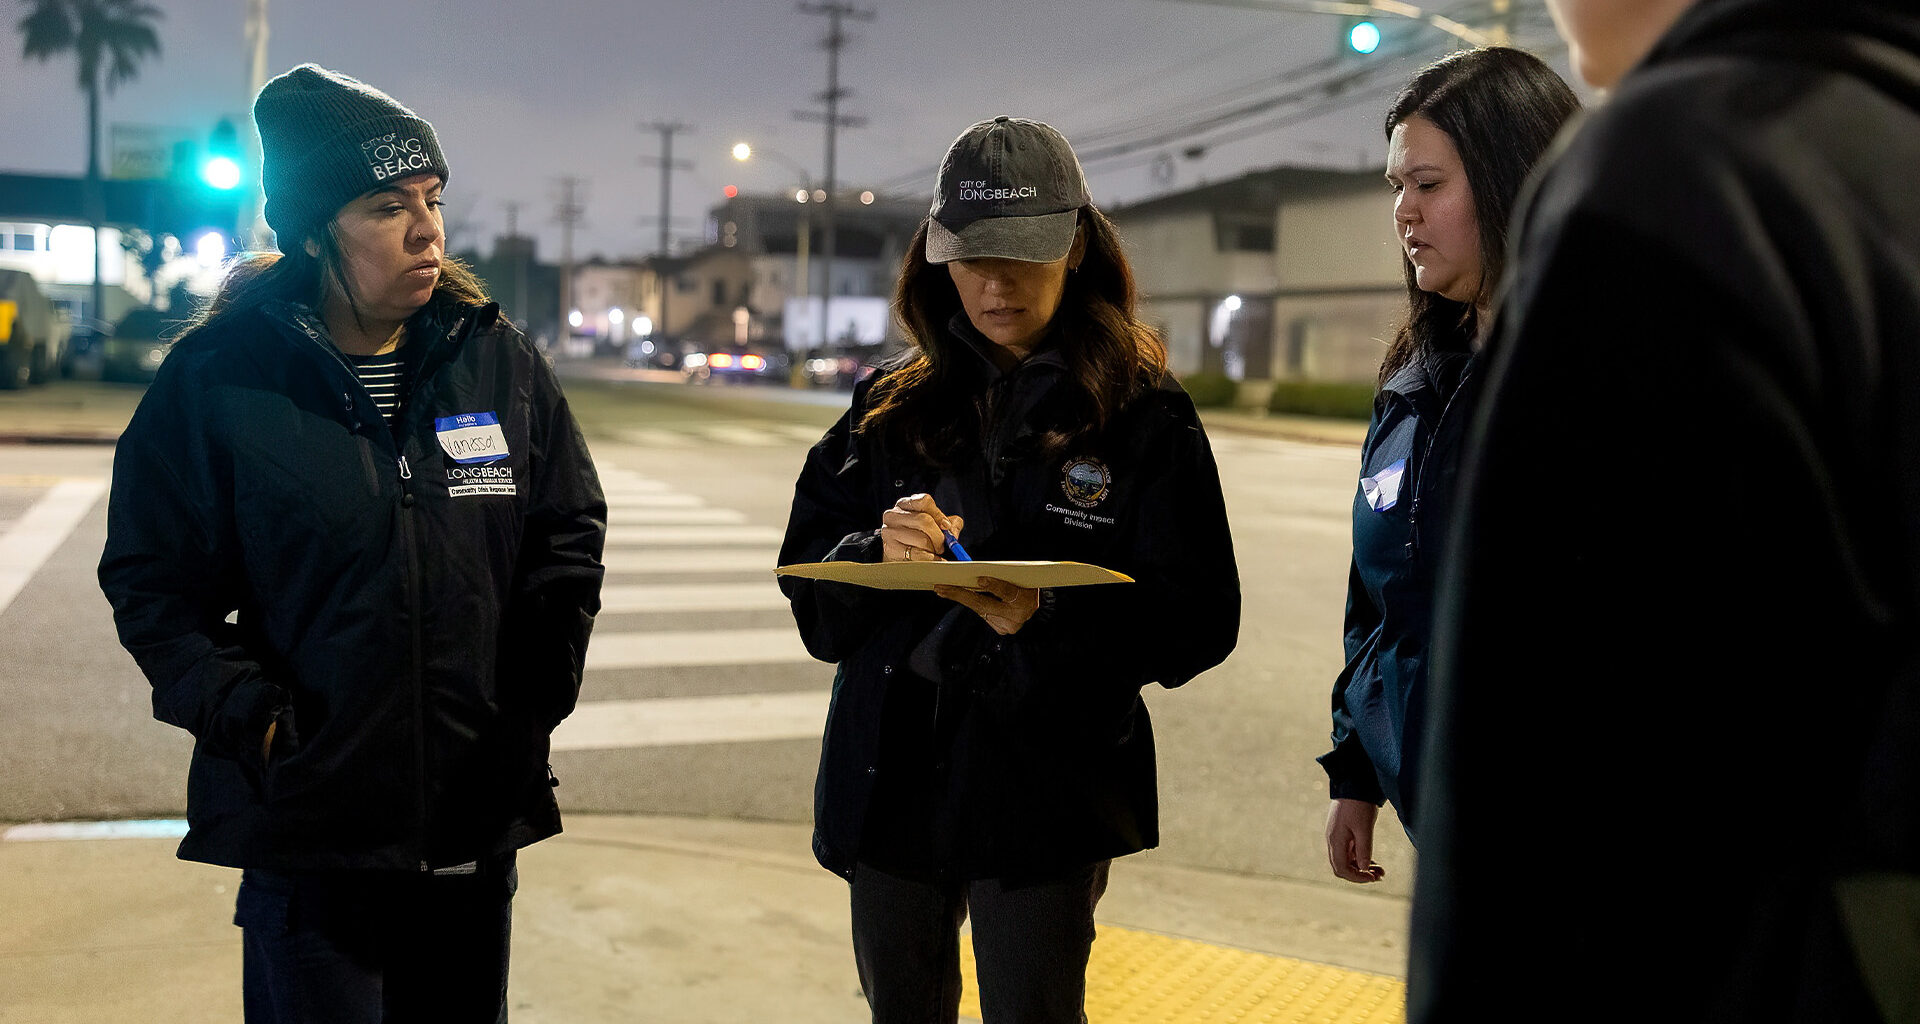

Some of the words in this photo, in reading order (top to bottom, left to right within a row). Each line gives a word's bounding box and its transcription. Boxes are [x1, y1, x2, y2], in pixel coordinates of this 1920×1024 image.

[361, 136, 382, 150] CITY
[382, 132, 397, 143] OF
[363, 138, 422, 166] LONG
[372, 151, 433, 181] BEACH
[959, 180, 975, 189] CITY
[975, 180, 987, 189] OF
[456, 415, 476, 425] Hello
[1045, 503, 1088, 521] Community
[1063, 516, 1093, 530] Division
